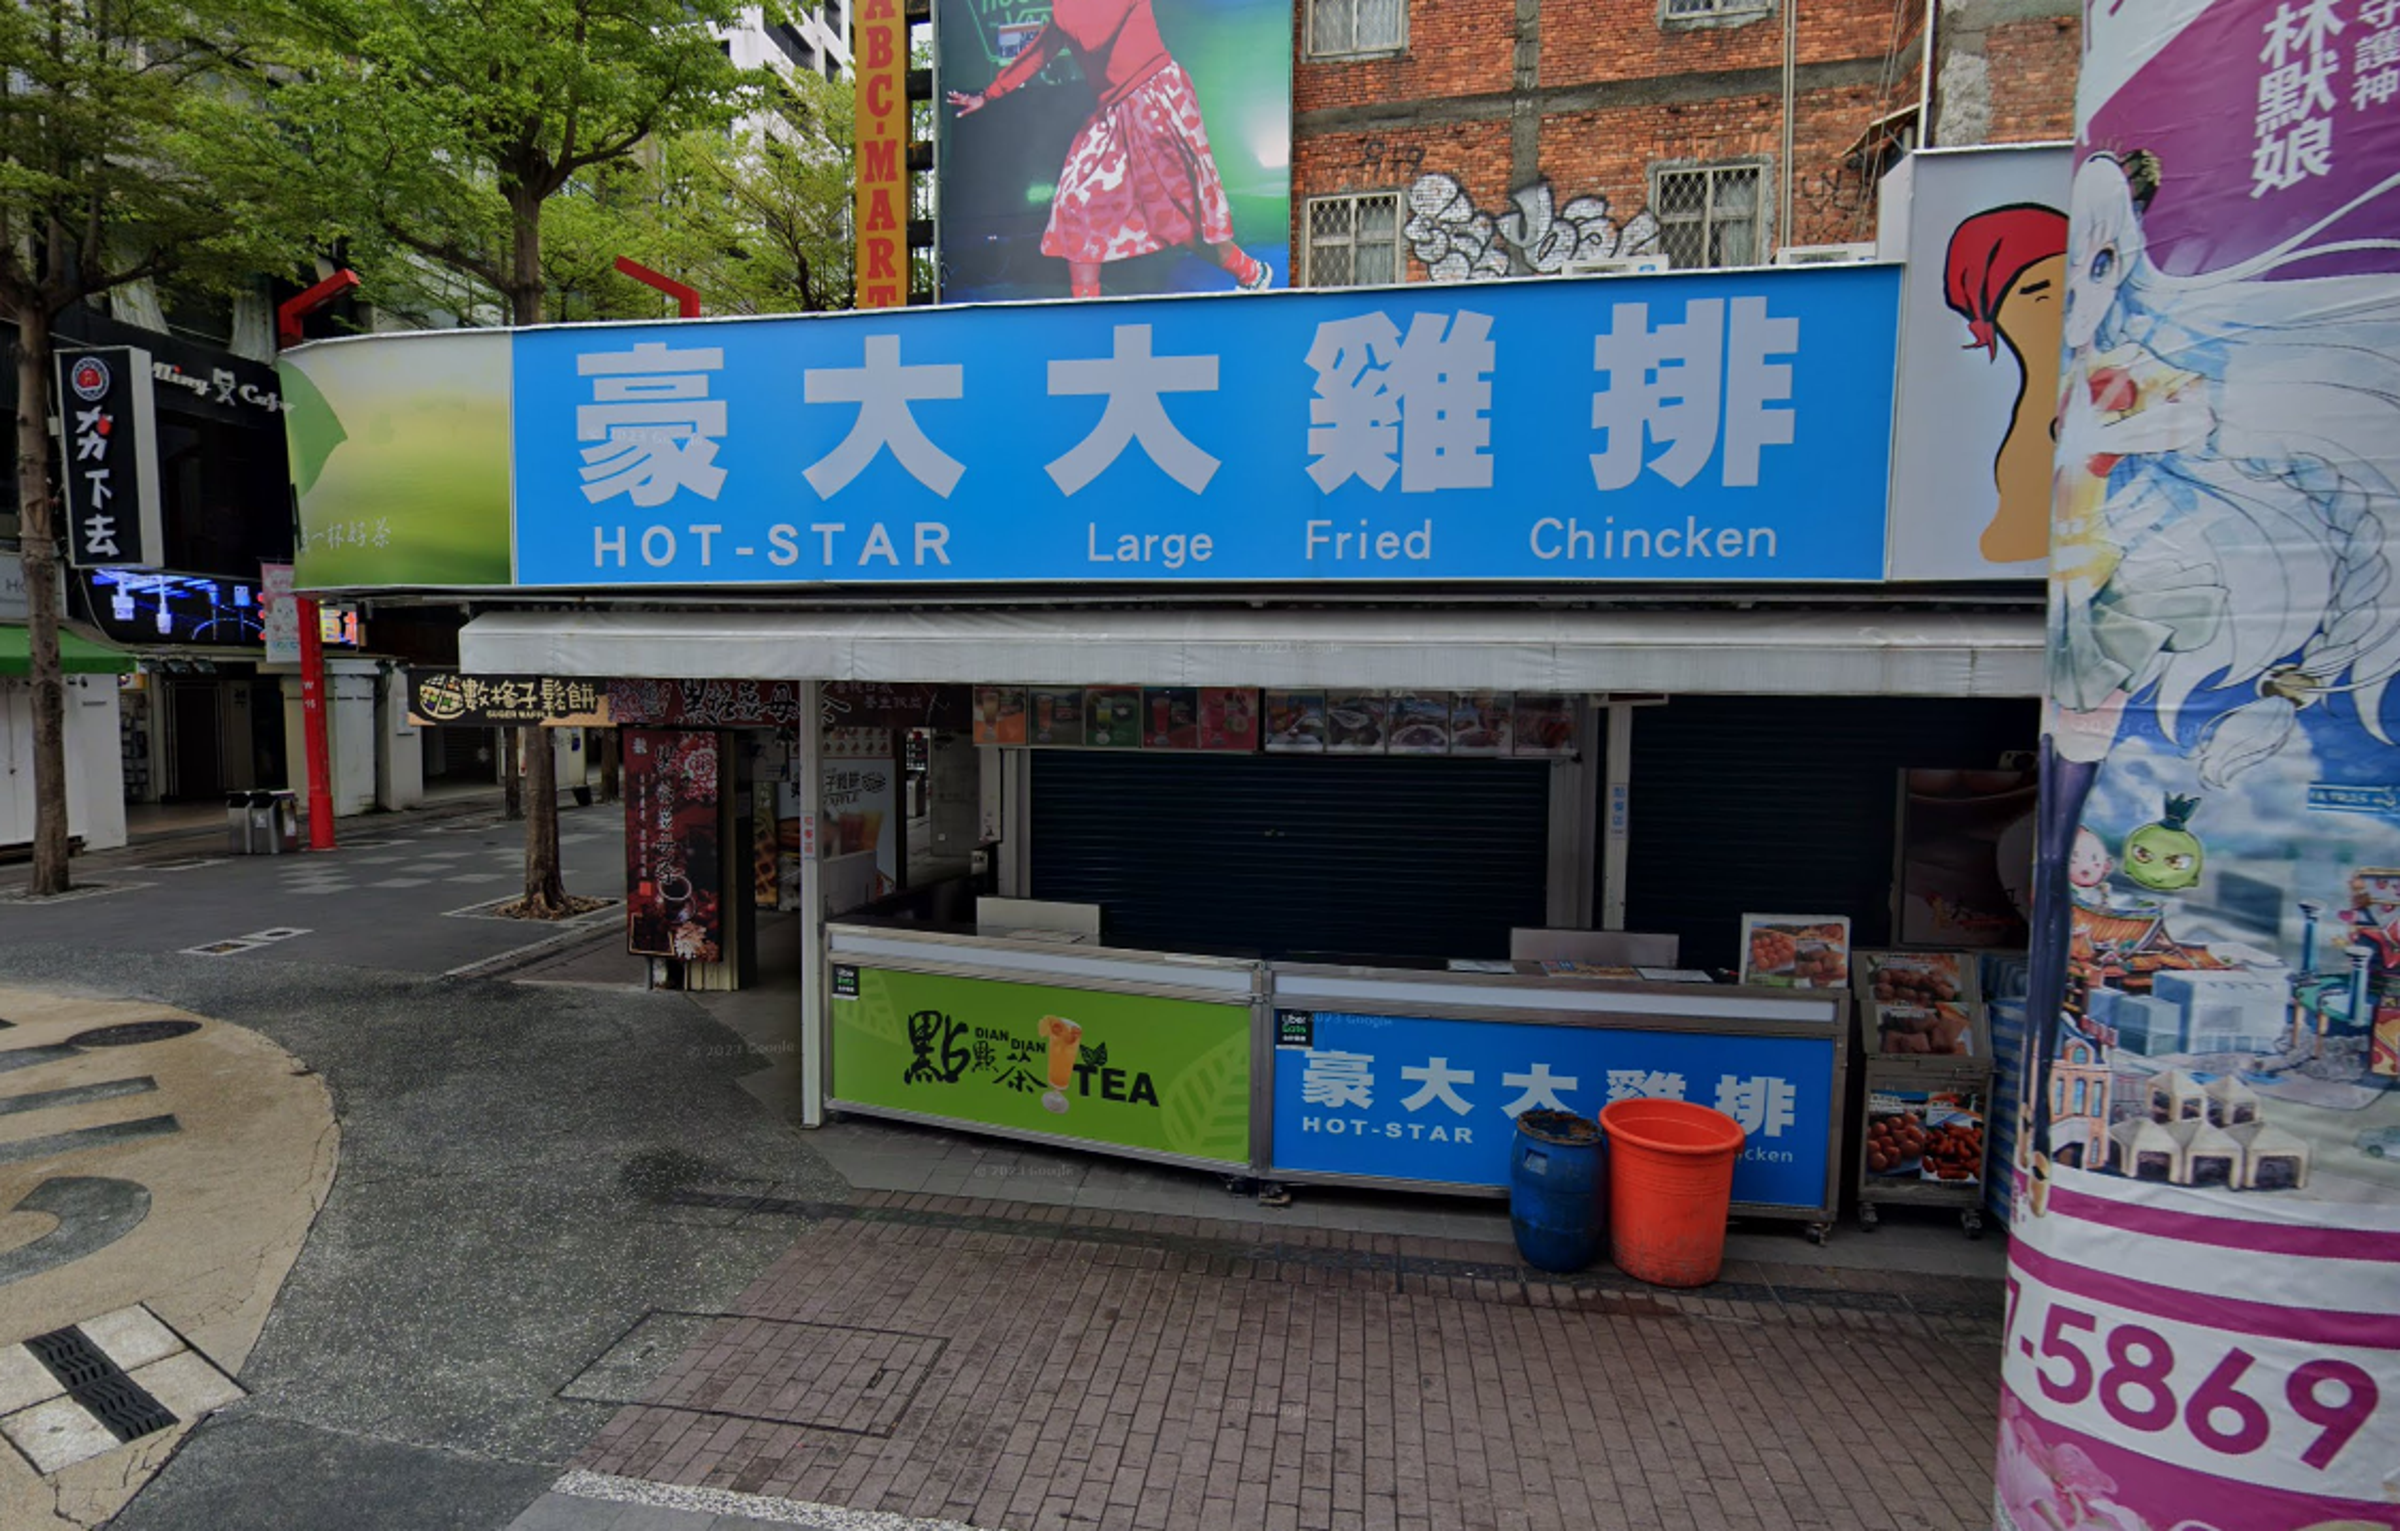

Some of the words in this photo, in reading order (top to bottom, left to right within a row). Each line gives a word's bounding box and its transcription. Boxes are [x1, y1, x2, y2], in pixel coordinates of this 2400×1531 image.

[2250, 0, 2346, 199] 林默娘
[575, 296, 1800, 507] 豪大大雞排
[593, 522, 951, 568] HOT-STAR
[1088, 522, 1214, 569] Large
[1305, 518, 1433, 560] Fried
[1528, 515, 1778, 560] Chincken
[975, 1026, 1009, 1042] DIAN
[1010, 1037, 1047, 1054] DIAN
[1072, 1063, 1160, 1108] TEA
[1302, 1116, 1474, 1144] HOT-STAR
